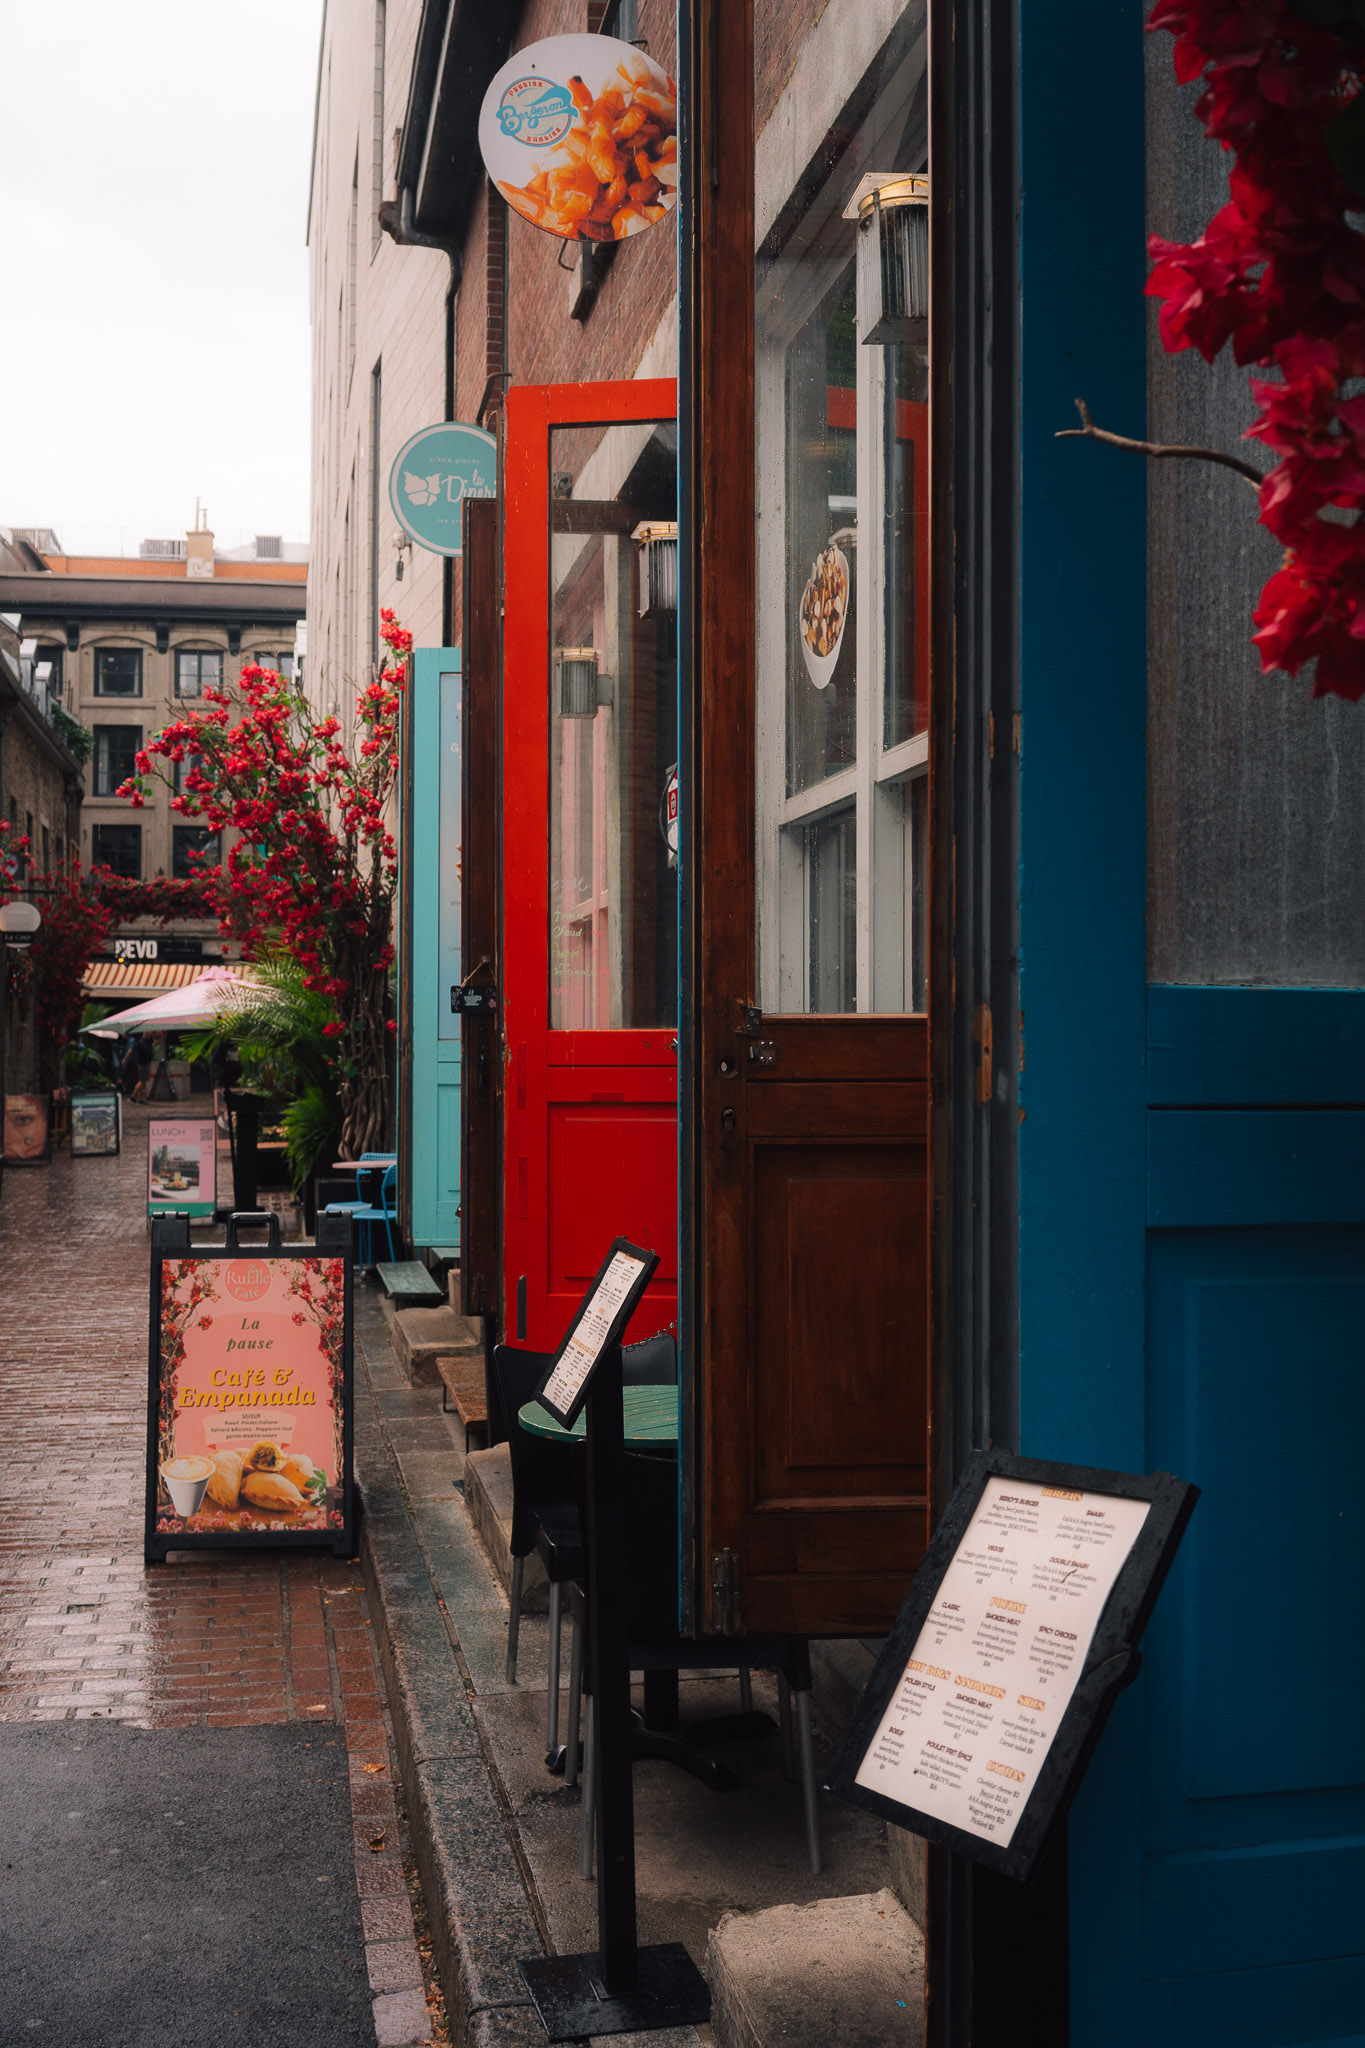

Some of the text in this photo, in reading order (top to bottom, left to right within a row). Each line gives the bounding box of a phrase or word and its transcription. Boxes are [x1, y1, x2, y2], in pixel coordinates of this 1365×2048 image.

[508, 80, 543, 96] POUTINE
[499, 100, 566, 136] Bergeron
[526, 127, 562, 142] CANTINE
[472, 468, 484, 486] la
[152, 1128, 185, 1136] LUNCH
[227, 1270, 271, 1285] RuElle
[234, 1285, 260, 1299] Café
[240, 1317, 260, 1331] La
[226, 1338, 274, 1352] pause
[210, 1368, 294, 1388] Café &
[179, 1386, 316, 1412] Empanada
[1050, 1557, 1071, 1565] DOUBLE
[942, 1602, 960, 1611] CLASSIC
[990, 1597, 1026, 1613] POUTINE
[986, 1613, 1006, 1622] SMOKED
[1054, 1630, 1077, 1640] CHICKEN
[907, 1660, 950, 1680] HOT DOGS
[905, 1677, 936, 1691] POLISH STYLE
[956, 1694, 992, 1709] SMOKED MEAT
[1018, 1696, 1045, 1711] SIDES
[889, 1727, 904, 1736] BOEUF
[926, 1740, 946, 1751] POULET
[957, 1751, 972, 1762] ÉPICÉ
[987, 1760, 1025, 1782] EXTRAS
[997, 1786, 1012, 1795] cheese
[983, 1813, 996, 1822] patty
[993, 1806, 1006, 1815] patty
